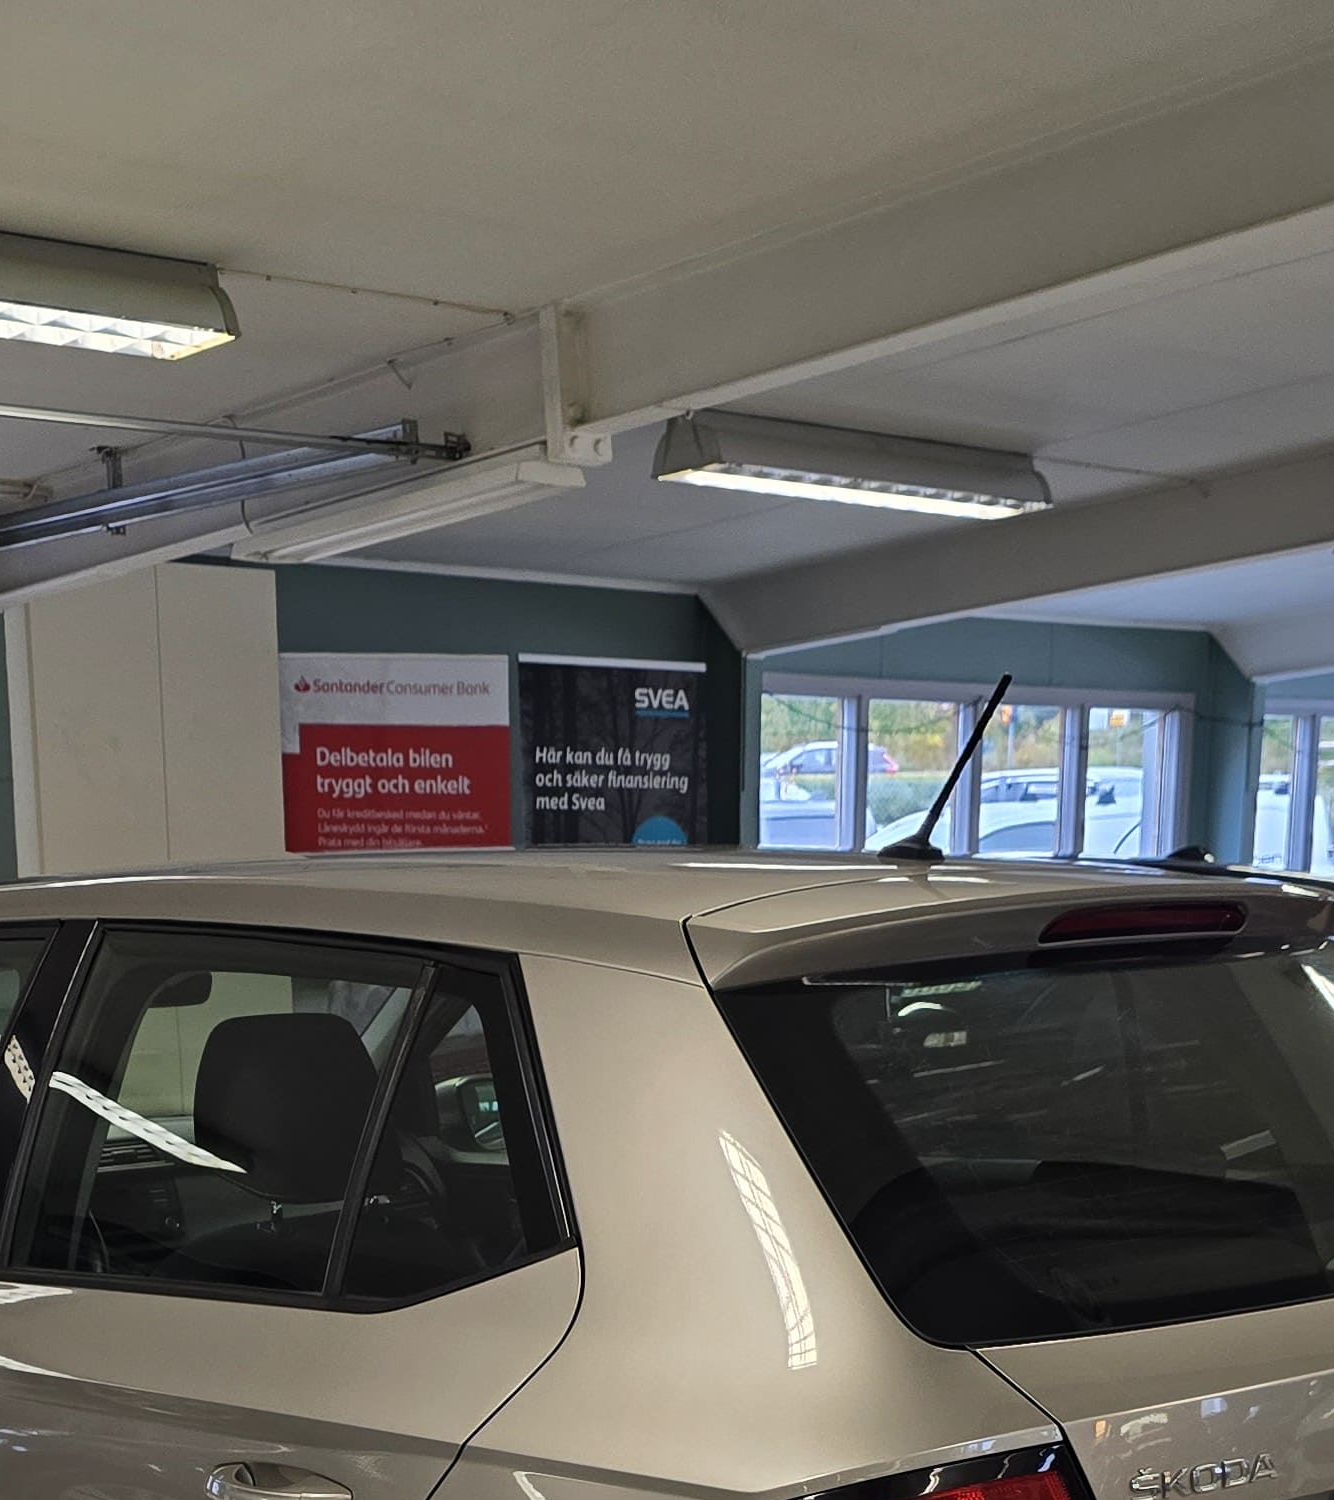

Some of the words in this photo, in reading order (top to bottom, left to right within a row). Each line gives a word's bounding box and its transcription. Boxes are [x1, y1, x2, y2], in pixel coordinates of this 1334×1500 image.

[313, 678, 384, 694] Santander
[386, 680, 454, 695] Consumer
[457, 681, 491, 696] Bank
[635, 688, 689, 710] SVEA
[316, 746, 404, 767] Delbetala
[409, 748, 453, 768] bilen
[535, 746, 563, 763] Här
[566, 746, 592, 765] kan
[596, 747, 614, 766] du
[617, 747, 631, 766] få
[635, 750, 671, 770] trygg
[317, 774, 372, 798] tryggt
[377, 774, 409, 794] och
[414, 775, 470, 795] enkelt
[535, 769, 562, 787] och
[567, 769, 605, 788] säker
[608, 770, 688, 793] finansiering
[536, 792, 568, 810] med
[571, 793, 605, 811] Svea
